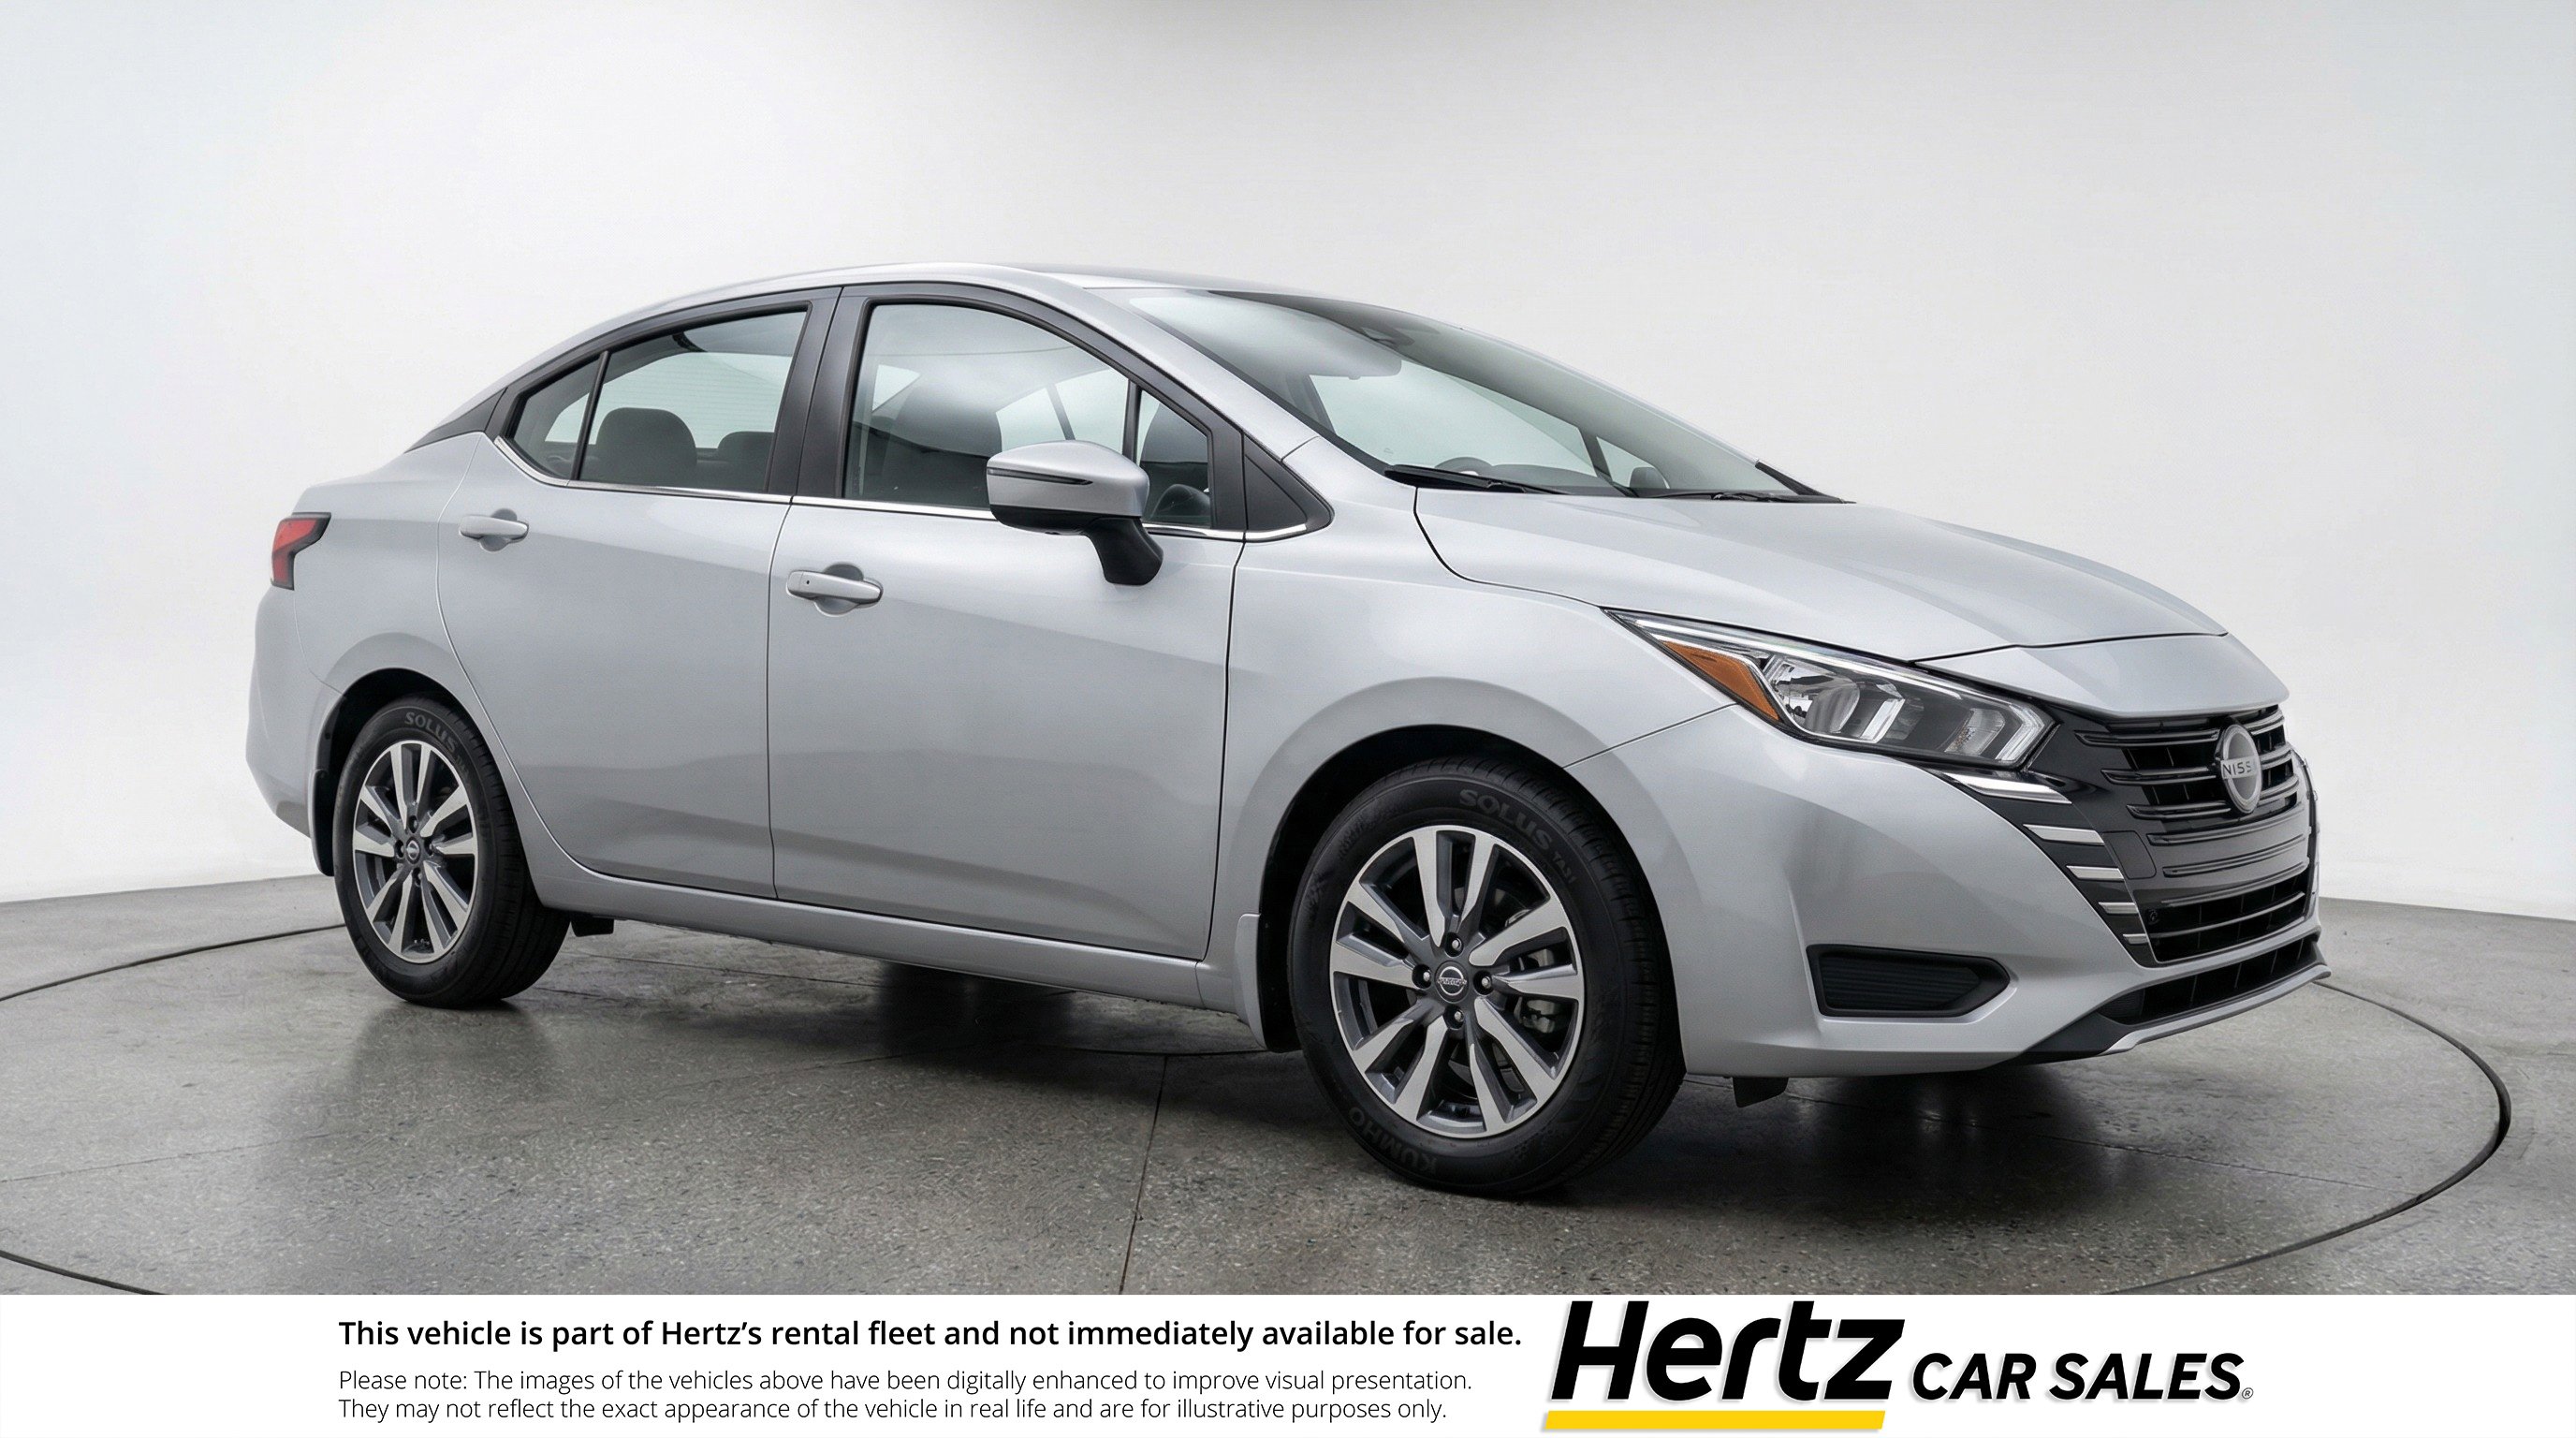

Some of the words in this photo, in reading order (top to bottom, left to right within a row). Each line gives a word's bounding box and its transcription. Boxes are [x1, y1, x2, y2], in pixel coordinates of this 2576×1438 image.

[403, 711, 456, 754] SOLUS
[1459, 788, 1553, 850] SOLUS
[1348, 1106, 1438, 1176] KUMHO
